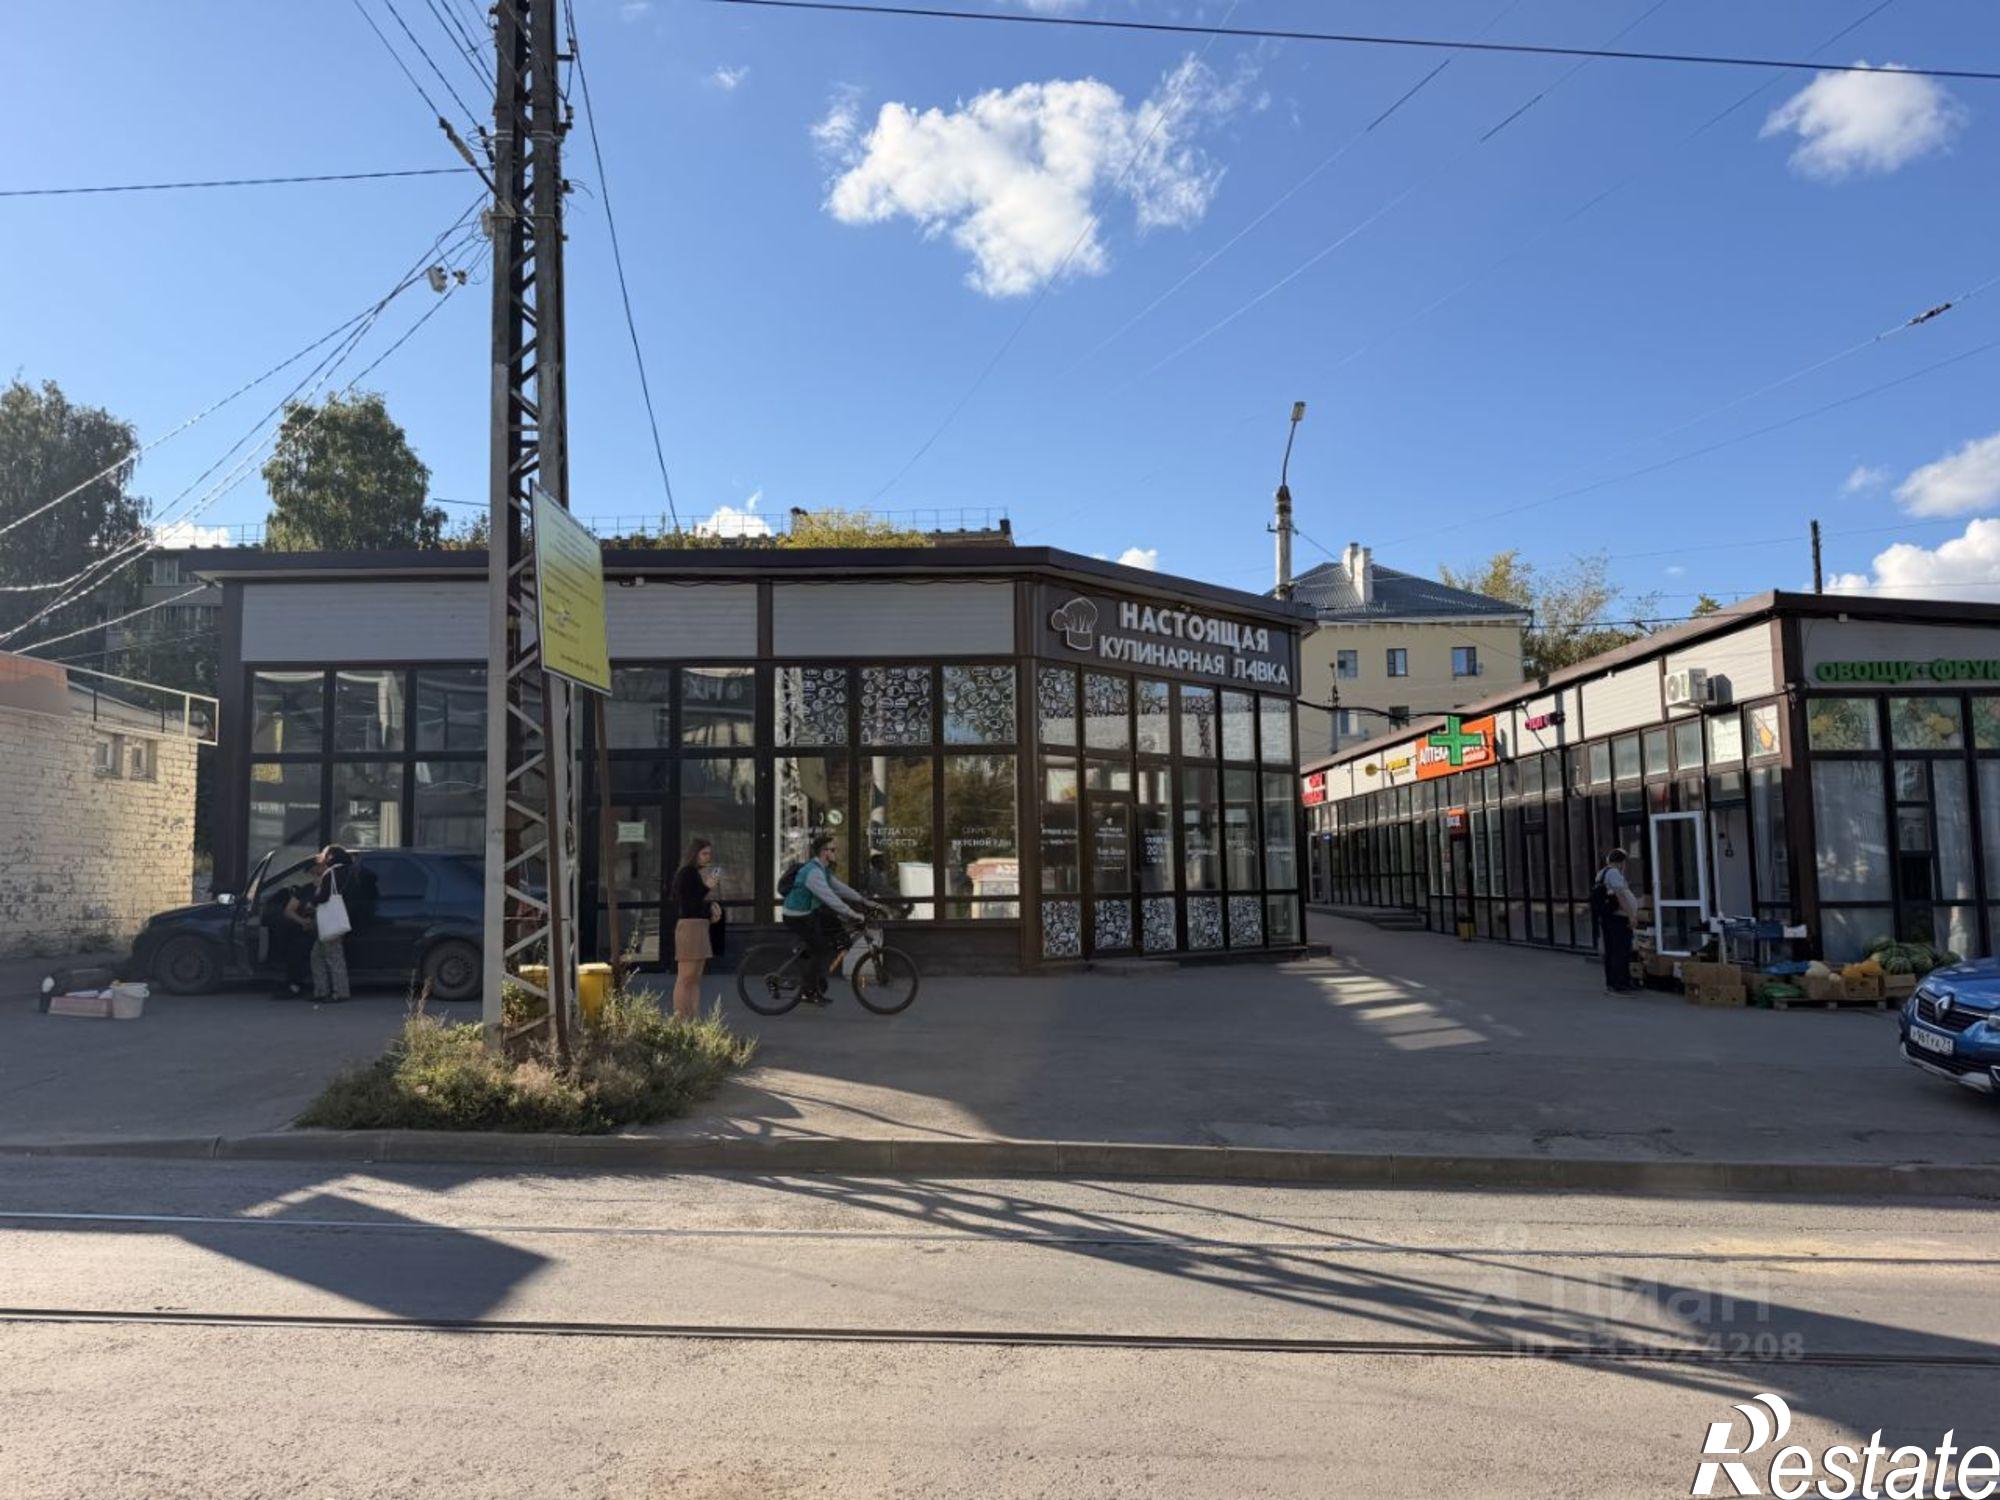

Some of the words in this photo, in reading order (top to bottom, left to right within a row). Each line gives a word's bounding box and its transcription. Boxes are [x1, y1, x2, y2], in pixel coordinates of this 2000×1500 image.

[1119, 601, 1269, 654] НАСТОЯЩАЯ
[1100, 635, 1225, 675] КУЛИНАРНАЯ
[1233, 658, 1290, 685] ЛАВКА
[1815, 661, 1912, 683] ОВОЩИ
